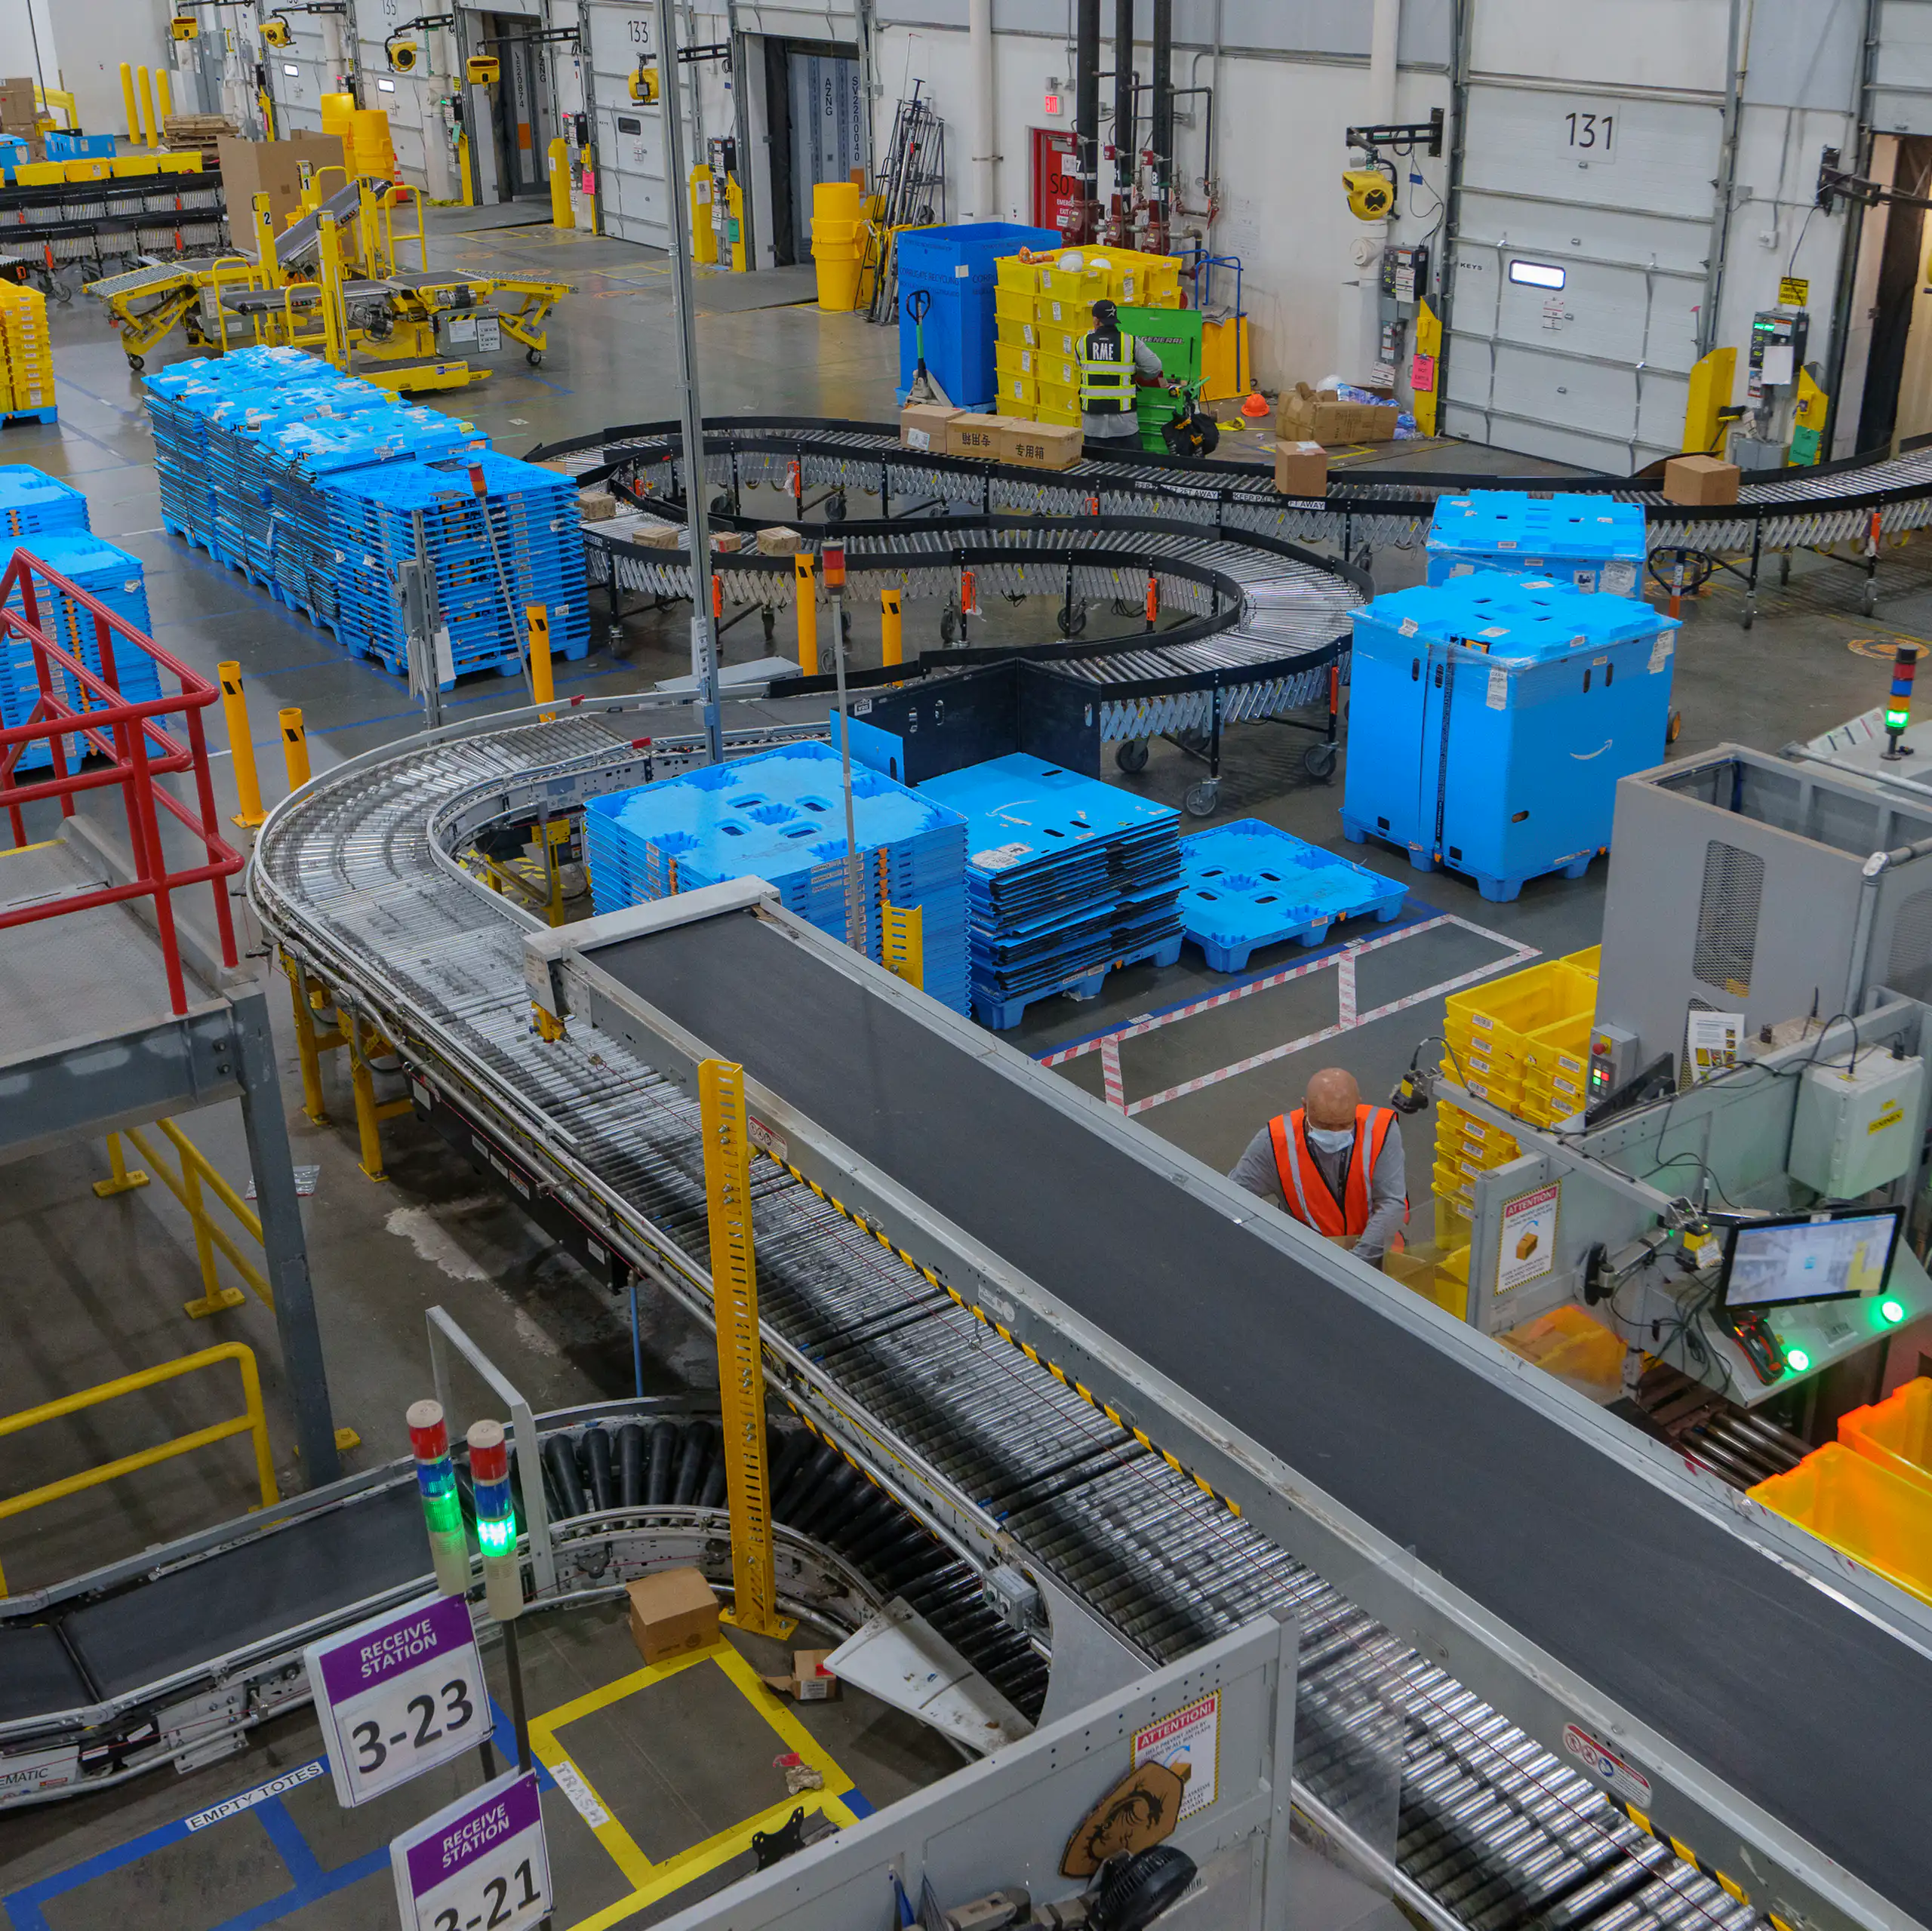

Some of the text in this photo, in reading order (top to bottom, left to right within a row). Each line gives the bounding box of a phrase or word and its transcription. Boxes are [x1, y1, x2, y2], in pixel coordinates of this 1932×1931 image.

[628, 20, 648, 43] 133
[825, 78, 833, 116] AZNG
[1045, 96, 1058, 113] EXIT
[1565, 112, 1613, 150] 131
[264, 212, 271, 225] 2
[1460, 263, 1483, 271] KEYS
[1093, 342, 1114, 361] RME
[1015, 444, 1044, 460] 专用箱
[1195, 490, 1218, 499] AWAY
[1232, 492, 1254, 501] KEEP
[1301, 501, 1325, 510] AWAY
[1509, 1188, 1555, 1214] ATTENTION!
[360, 1619, 432, 1663] RECEIVE
[360, 1632, 438, 1678] STATION
[352, 1679, 473, 1773] 3-23
[1141, 1702, 1212, 1747] ATTENTION!
[190, 1765, 320, 1828] EMPTY TOTES
[557, 1763, 604, 1822] TRASH
[442, 1802, 506, 1853] RECEIVE
[442, 1816, 509, 1868] STATION
